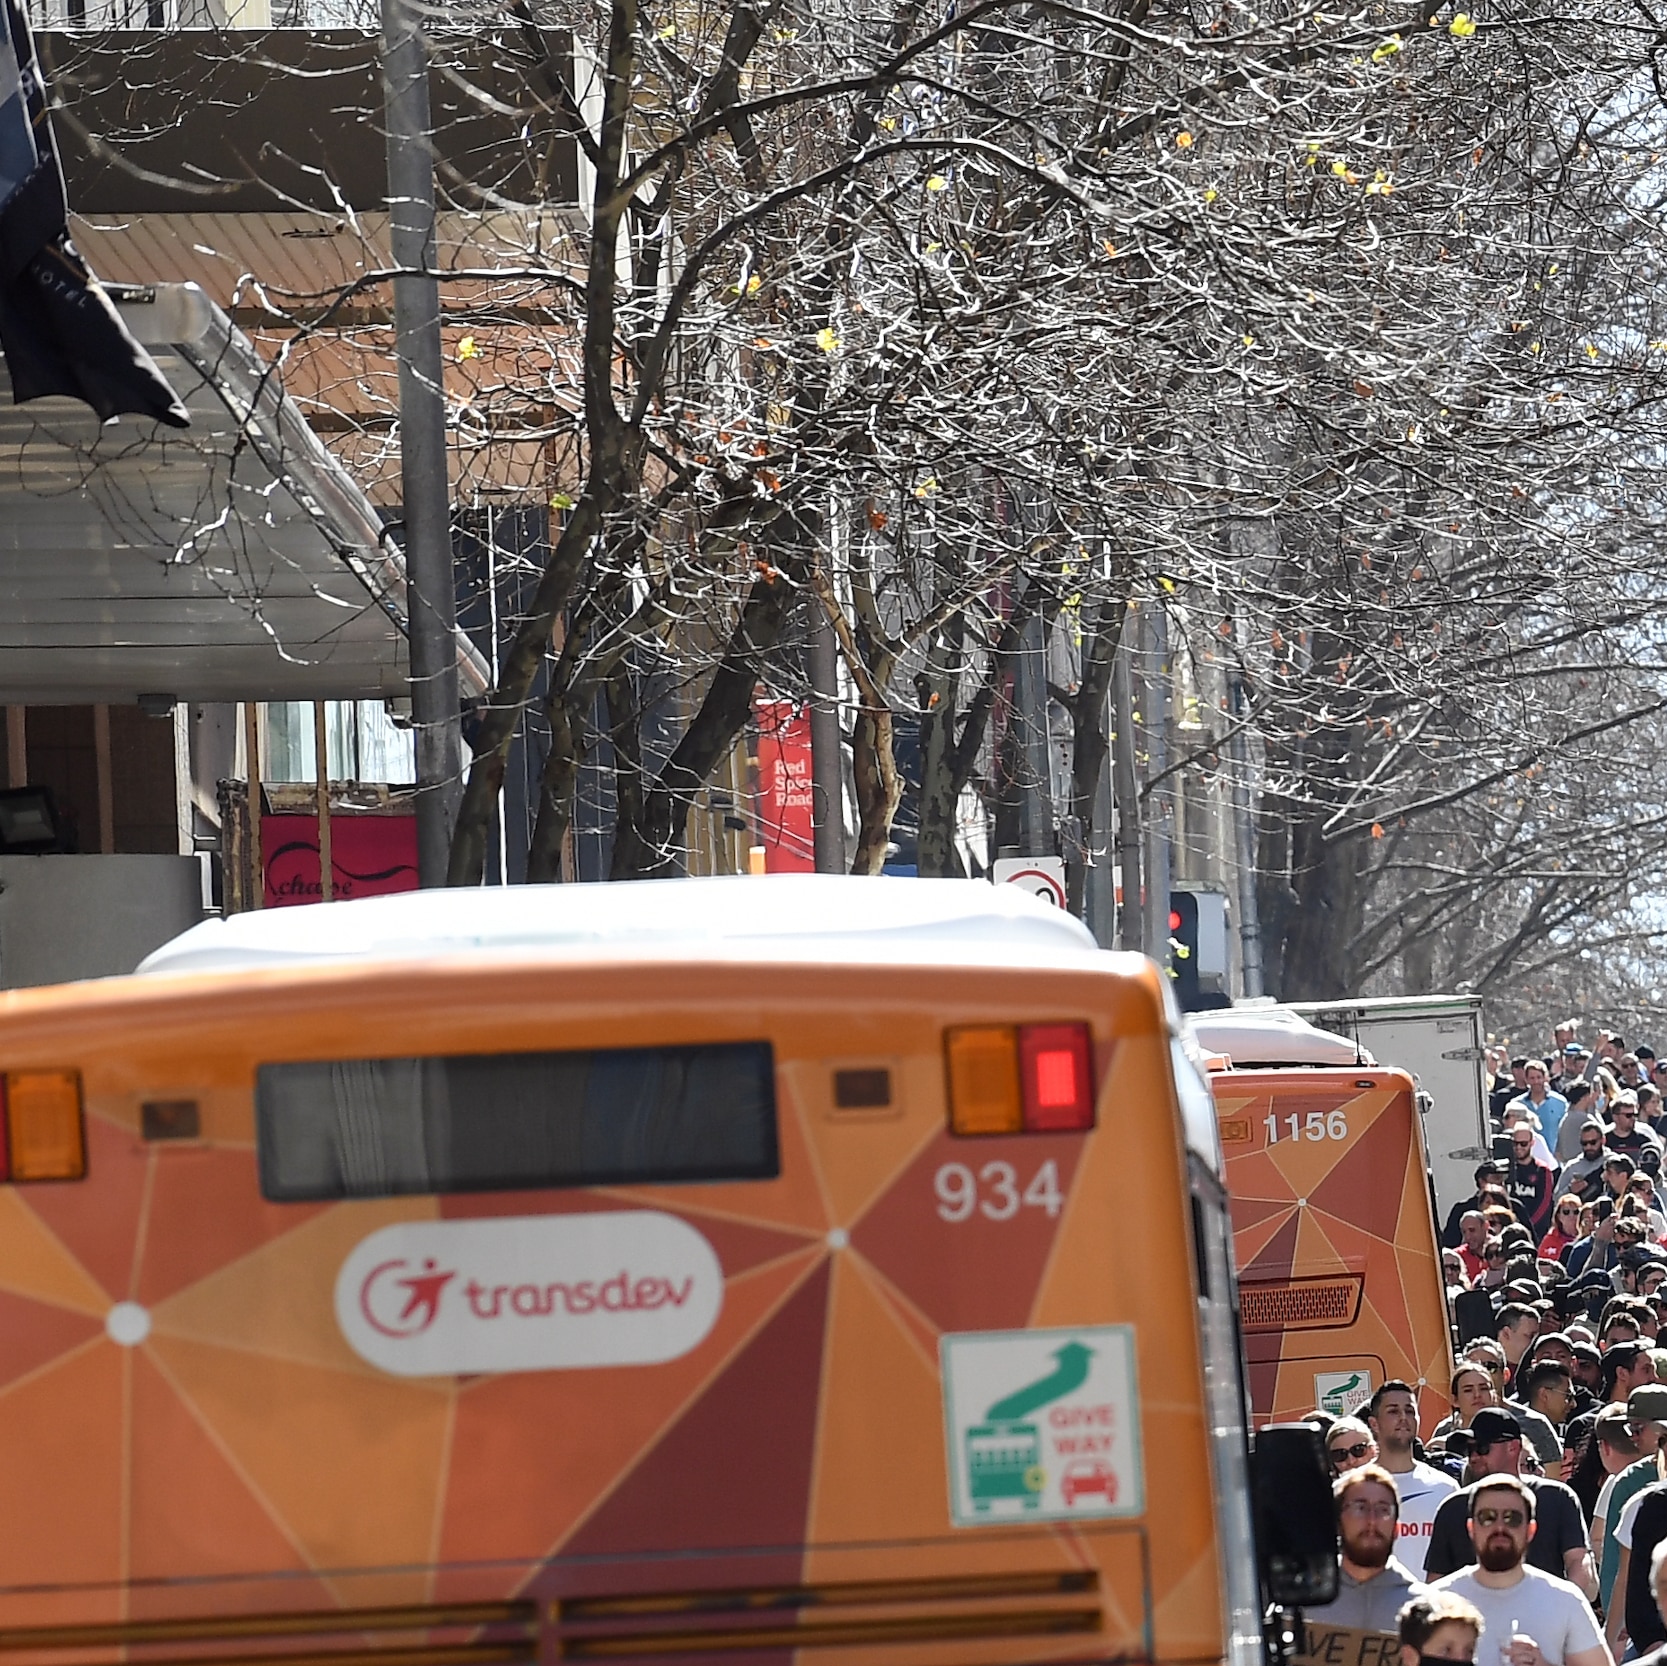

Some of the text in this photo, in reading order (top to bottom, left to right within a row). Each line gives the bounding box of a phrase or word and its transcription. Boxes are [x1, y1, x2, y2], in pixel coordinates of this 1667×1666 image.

[774, 759, 806, 775] Red
[1262, 1110, 1348, 1143] 1156
[934, 1159, 1064, 1223] 934
[464, 1269, 695, 1320] transdev
[1347, 1390, 1371, 1398] GIVE
[1048, 1403, 1115, 1429] GIVE
[1053, 1433, 1115, 1454] WAY
[1401, 1522, 1434, 1537] DO IT
